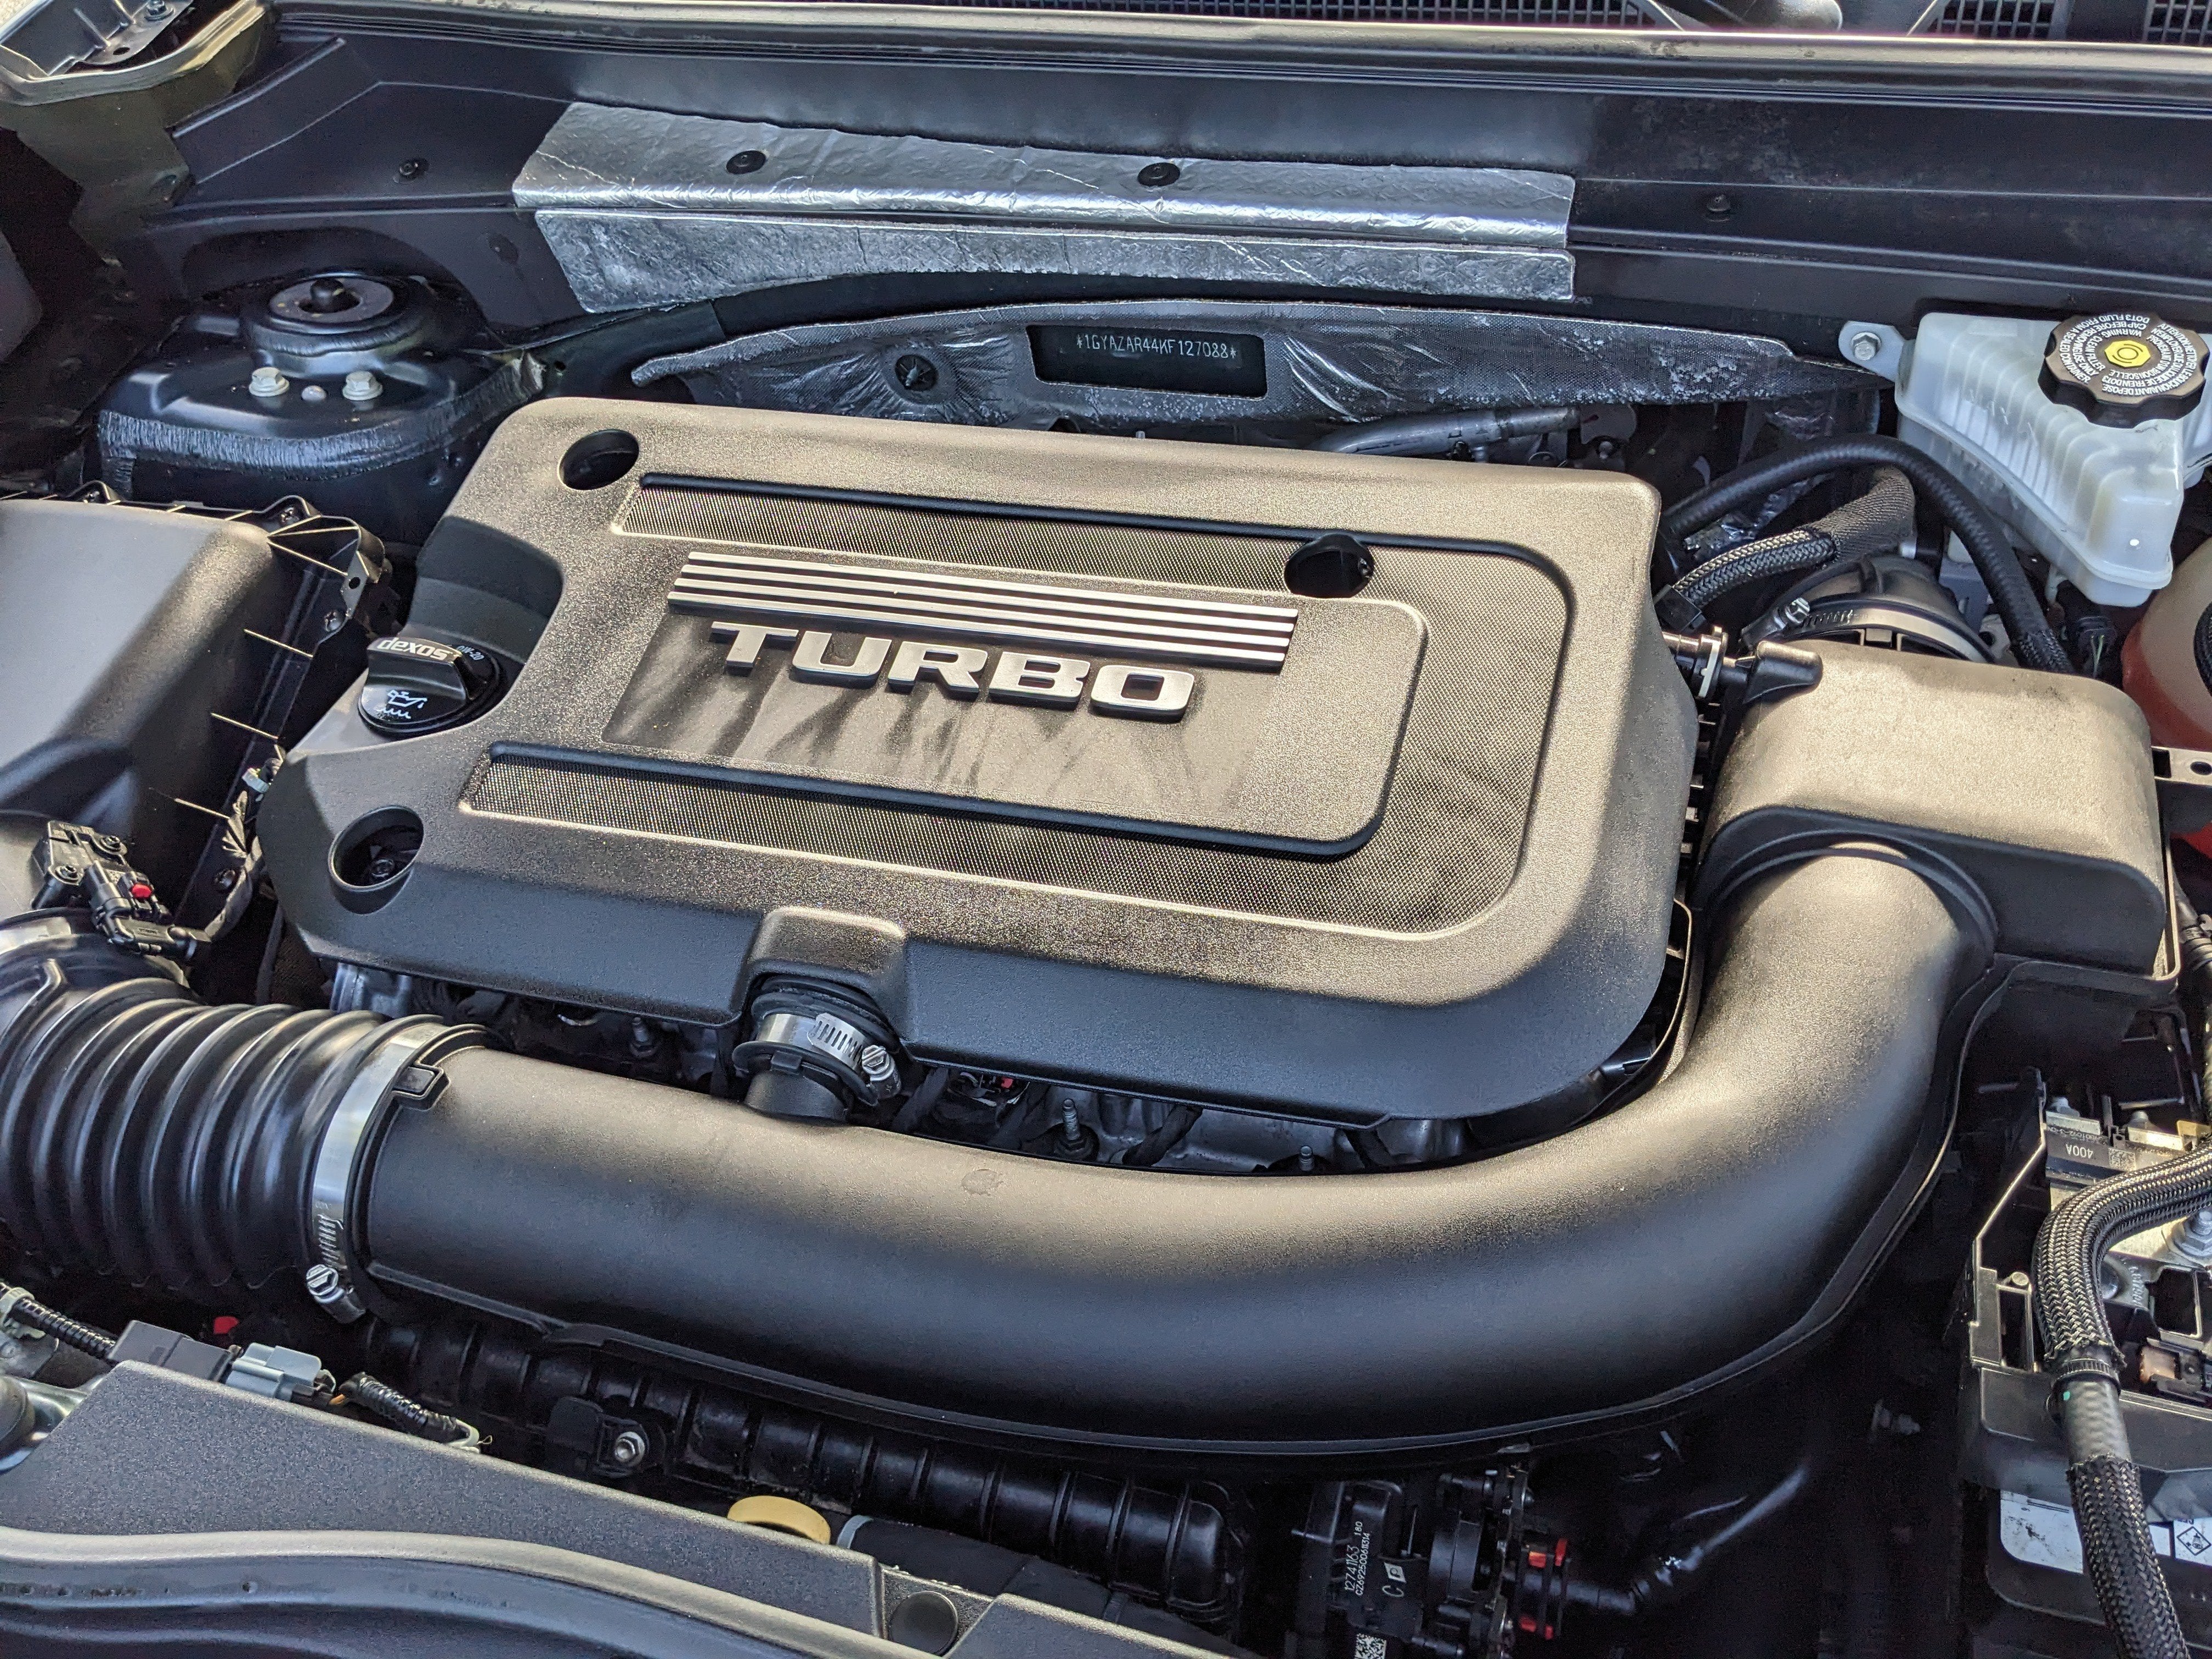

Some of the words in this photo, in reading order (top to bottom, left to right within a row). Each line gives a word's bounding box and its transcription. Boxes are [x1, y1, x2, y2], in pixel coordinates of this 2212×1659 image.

[2075, 318, 2100, 331] FROM
[2125, 314, 2150, 324] DOT3
[2092, 321, 2127, 332] BEFORE
[2127, 321, 2147, 330] CAP
[2059, 331, 2076, 353] SEALED
[2085, 335, 2103, 353] CLEAN
[2072, 352, 2086, 364] USE
[2085, 353, 2106, 371] FILLER
[2173, 352, 2185, 364] QUE
[2078, 362, 2100, 376] ONLY
[2137, 367, 2162, 379] BIDON
[2101, 375, 2123, 386] DOT3
[2121, 379, 2146, 388] FREIN
[2156, 373, 2189, 392] BOUCHON
[2132, 386, 2162, 396] AVANT
[710, 620, 1196, 720] TURBO
[2065, 1143, 2094, 1159] 400A
[1344, 1544, 1360, 1591] 12741163
[1353, 1521, 1363, 1536] 180
